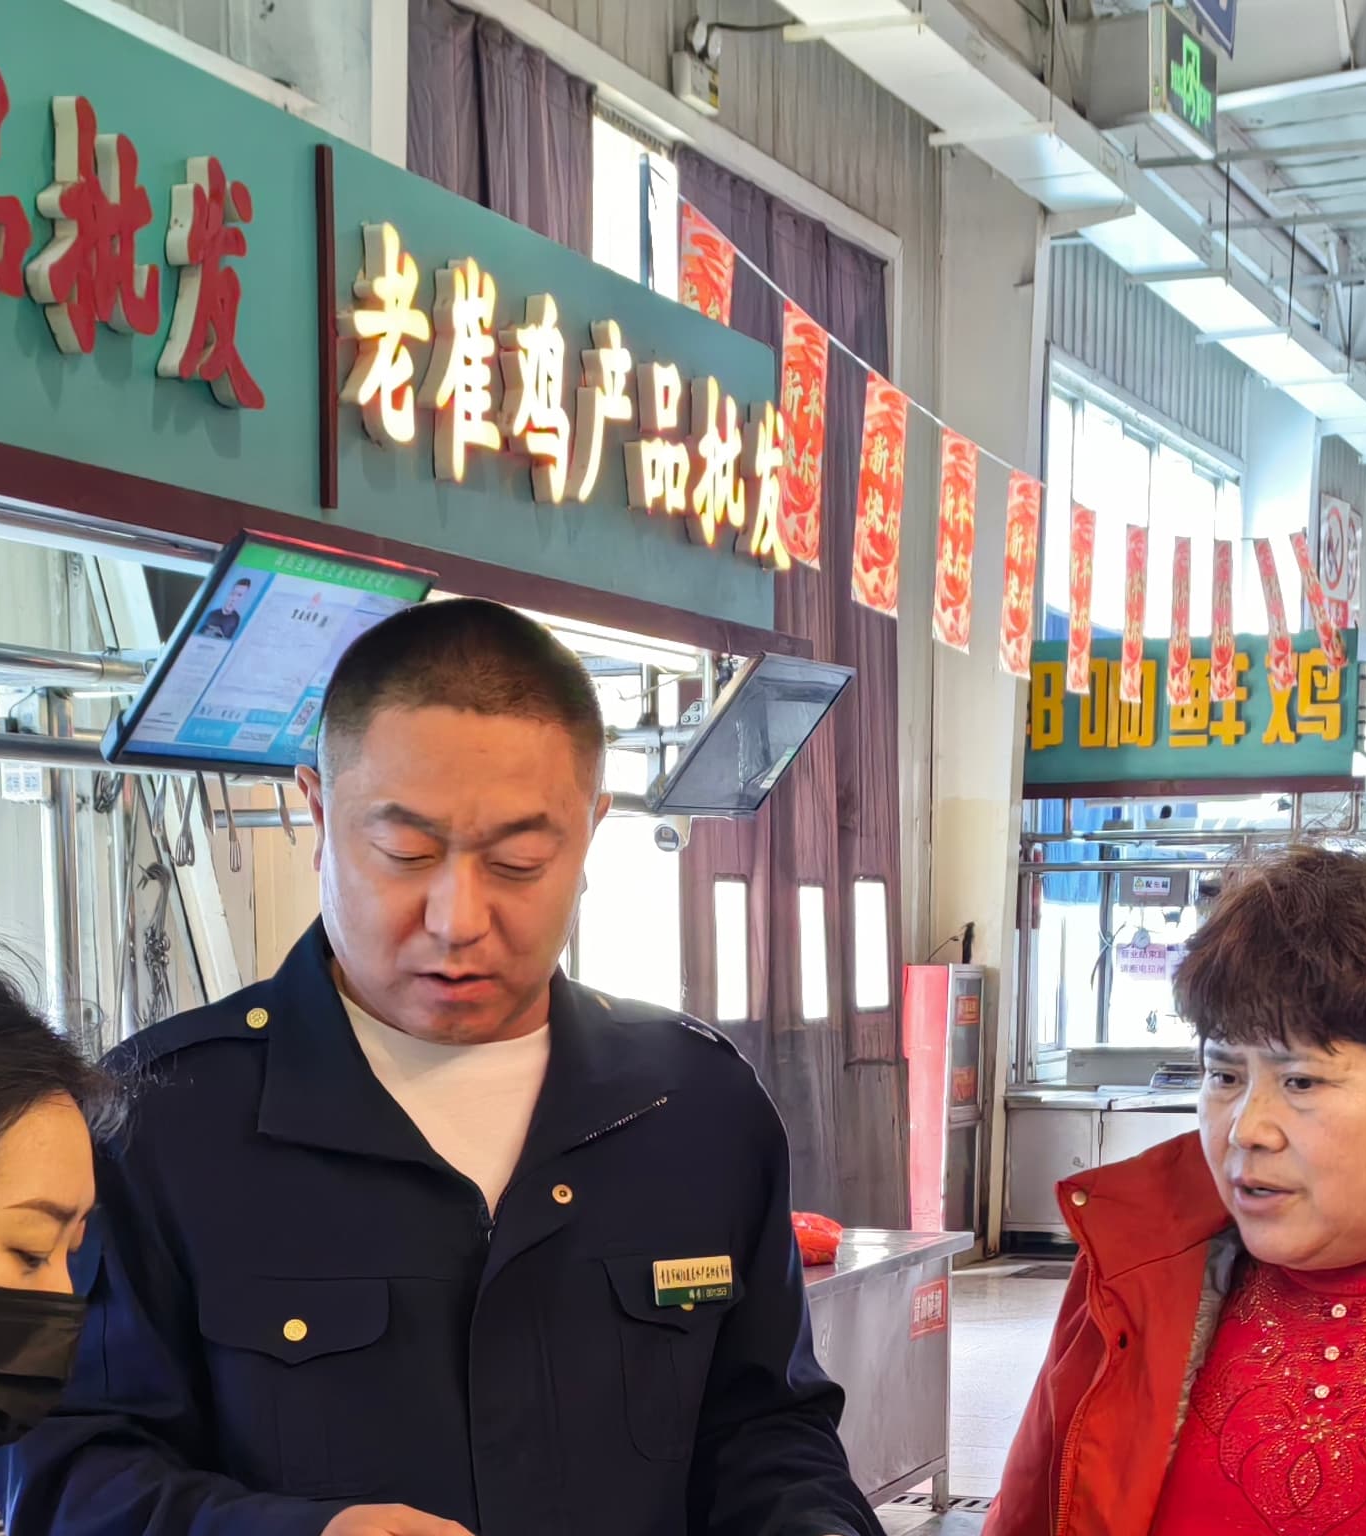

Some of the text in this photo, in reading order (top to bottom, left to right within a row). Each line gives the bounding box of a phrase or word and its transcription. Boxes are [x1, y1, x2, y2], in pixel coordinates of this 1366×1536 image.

[338, 221, 791, 571] 老崔鸡产品批发
